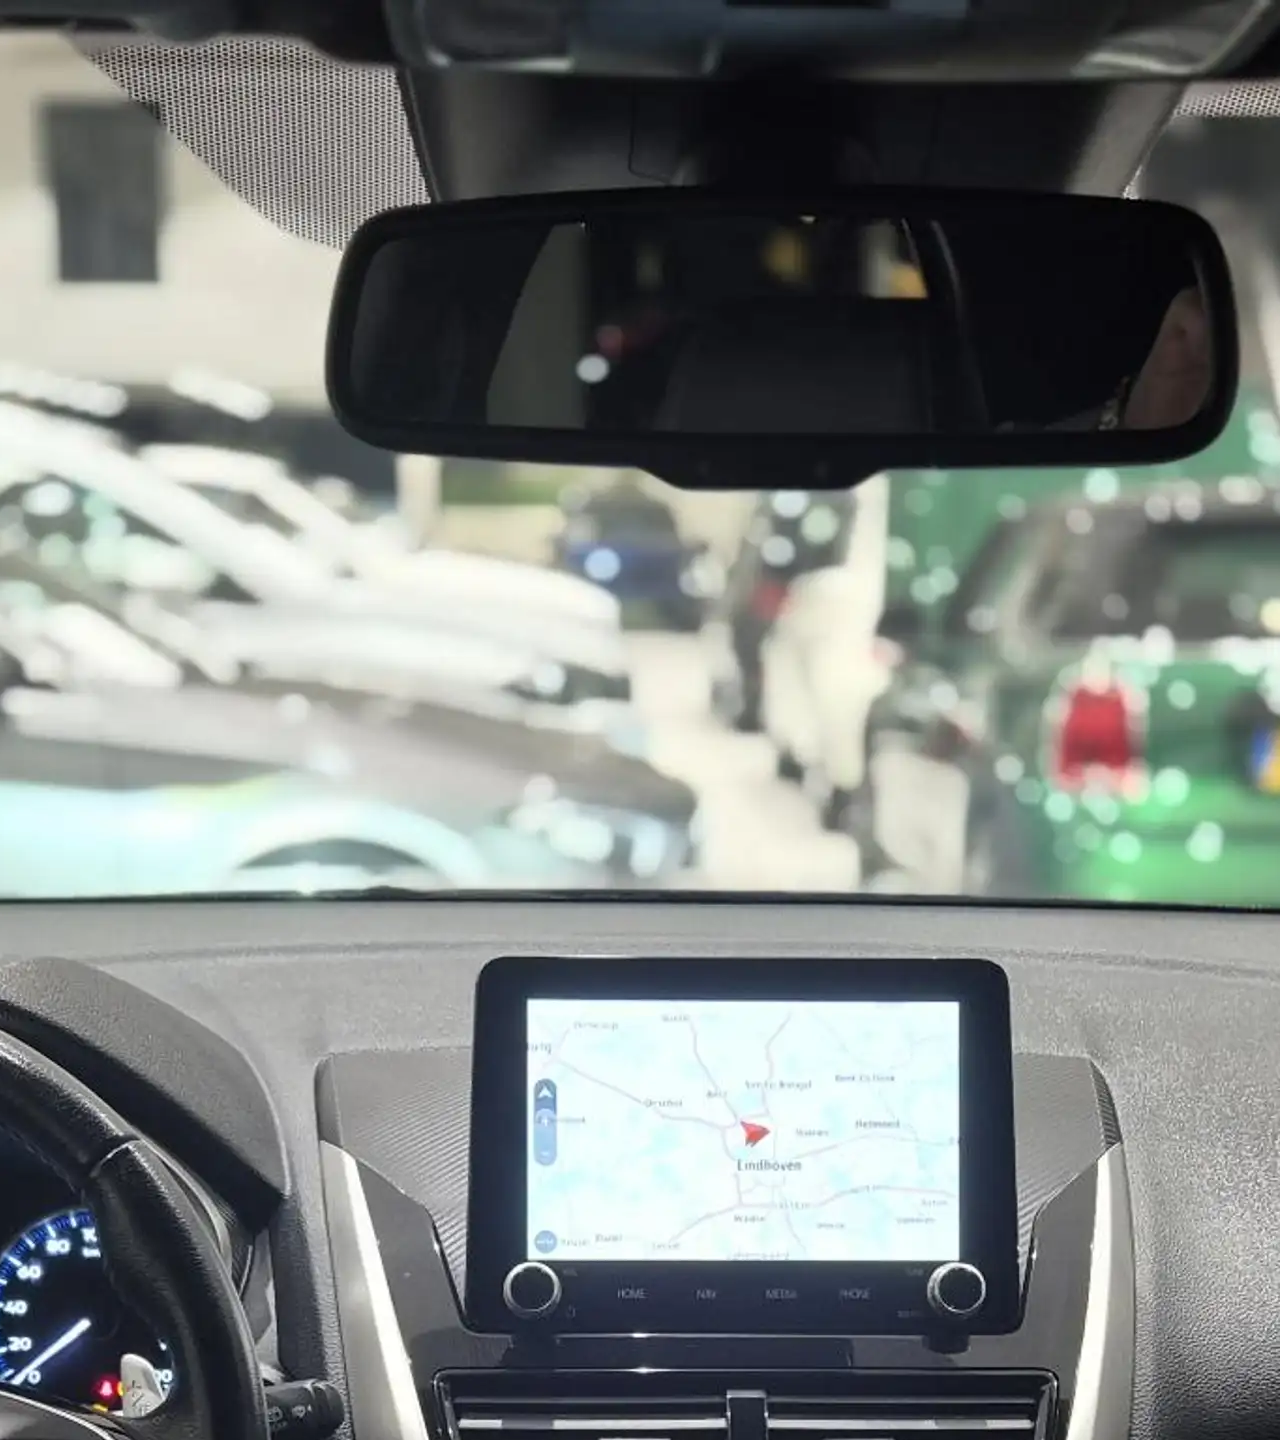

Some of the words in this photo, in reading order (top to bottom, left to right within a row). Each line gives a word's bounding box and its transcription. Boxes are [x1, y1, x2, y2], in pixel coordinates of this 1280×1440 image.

[16, 1265, 42, 1281] 60
[617, 1288, 647, 1299] HOME
[3, 1304, 27, 1315] 40
[7, 1337, 32, 1351] 20
